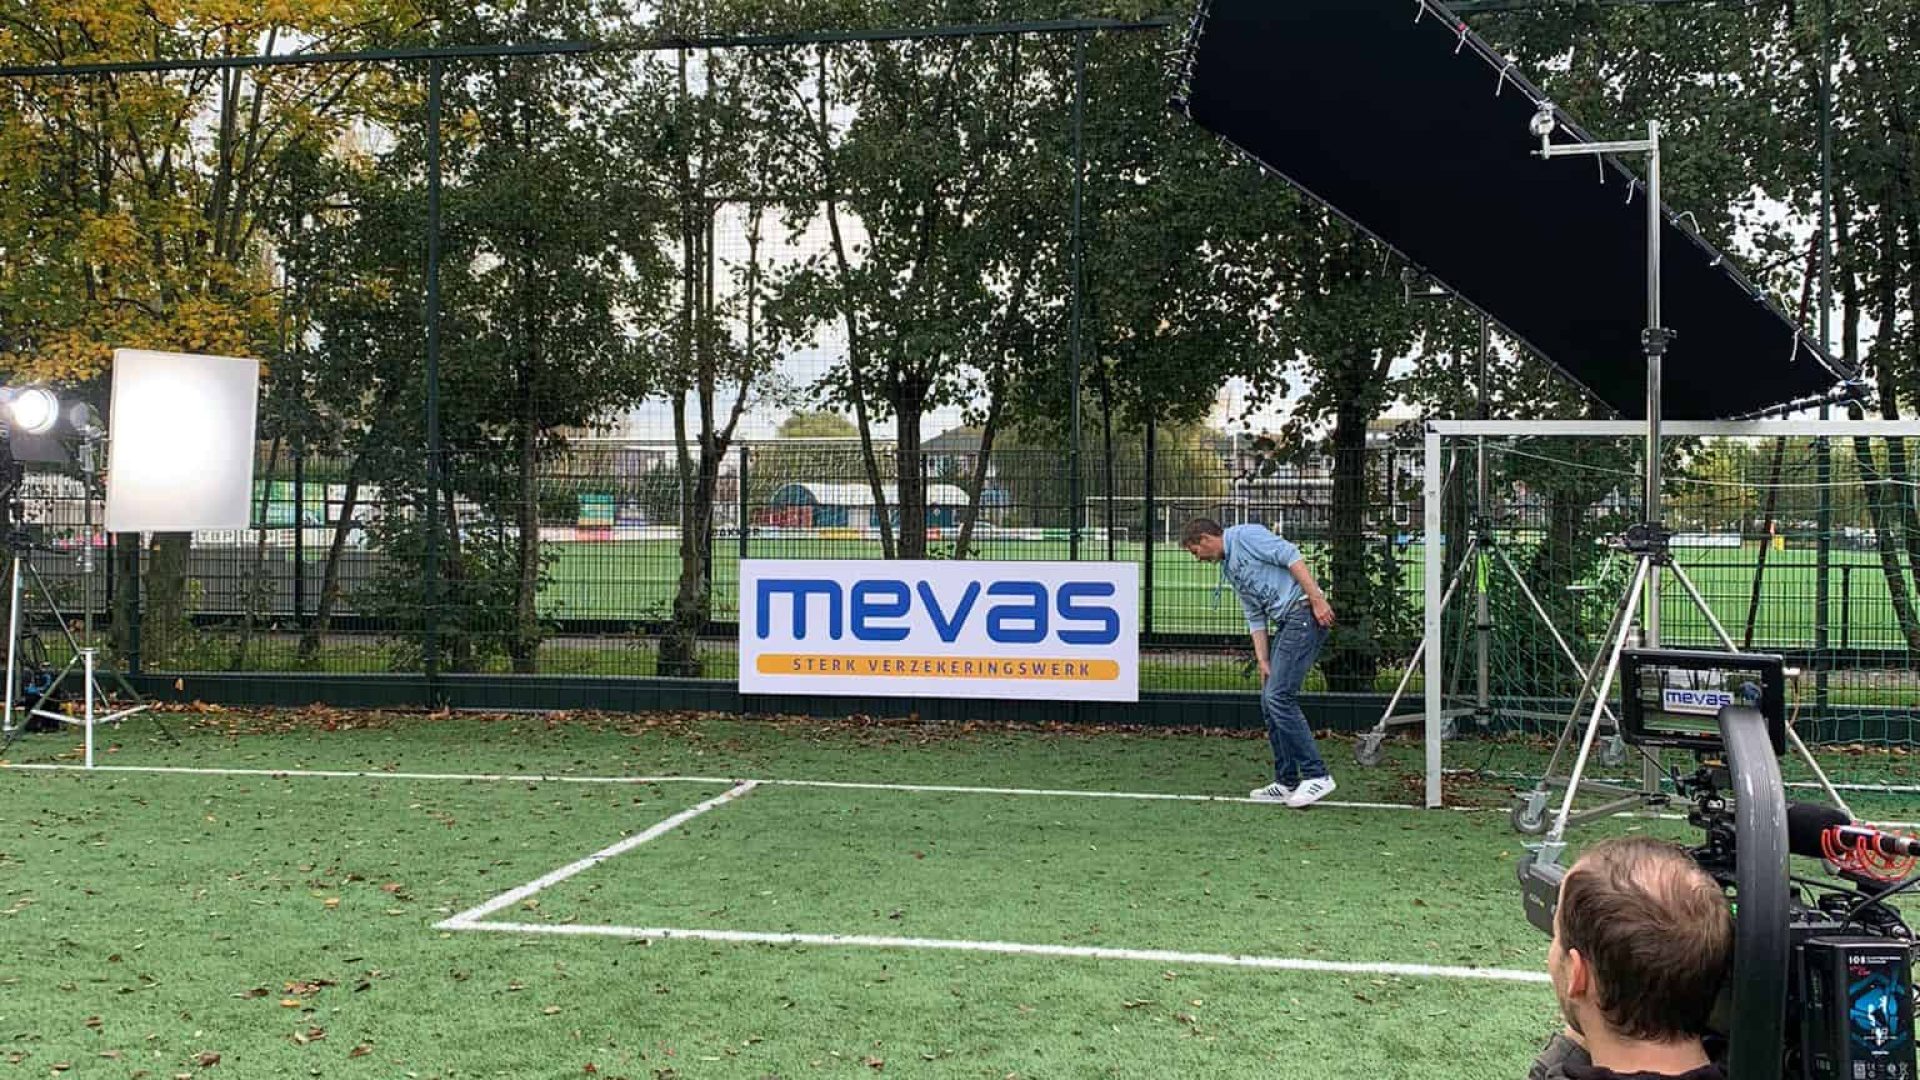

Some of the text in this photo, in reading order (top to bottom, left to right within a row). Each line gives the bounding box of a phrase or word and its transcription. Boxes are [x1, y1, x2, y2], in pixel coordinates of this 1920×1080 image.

[756, 579, 1120, 645] mevas
[792, 658, 1091, 677] STERK VERZEKERINGSWERK
[1667, 691, 1730, 707] mevas
